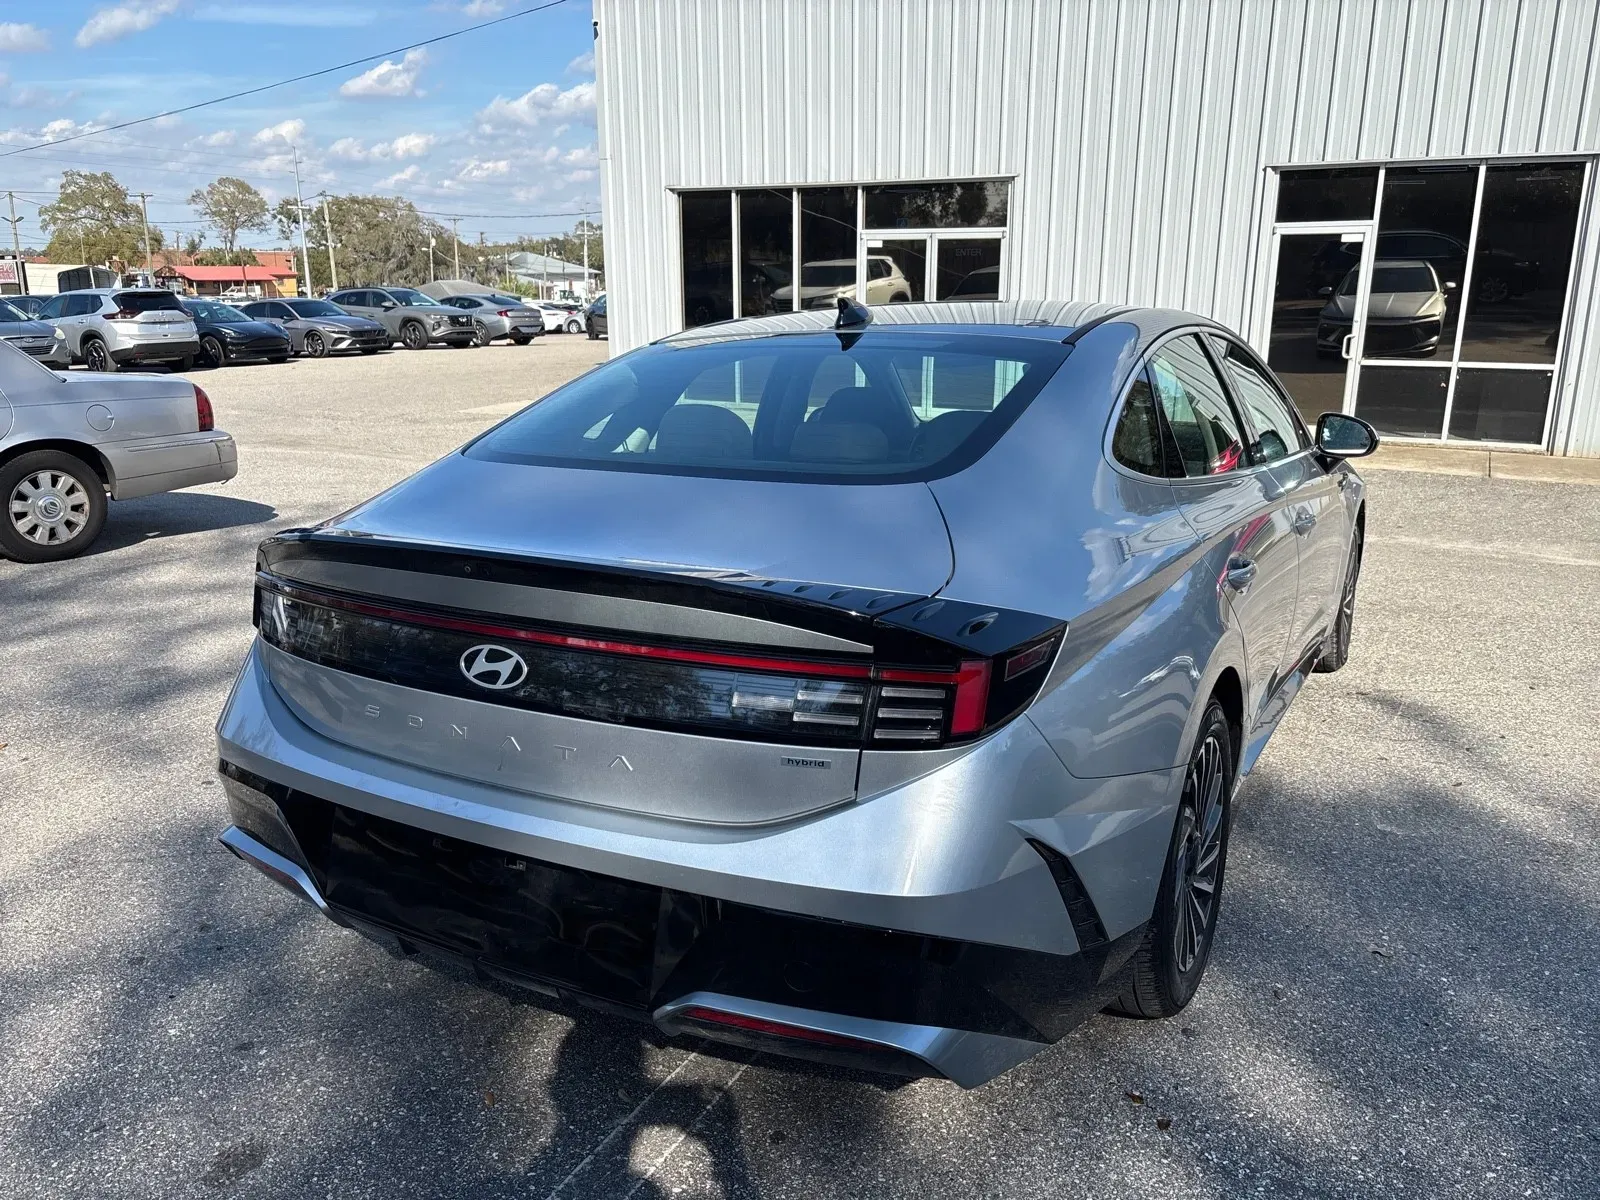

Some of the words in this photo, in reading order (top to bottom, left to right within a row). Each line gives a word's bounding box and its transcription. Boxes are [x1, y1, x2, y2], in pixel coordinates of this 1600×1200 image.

[955, 248, 982, 257] ENTER
[364, 704, 633, 771] SONATA
[787, 758, 825, 768] hybrid
